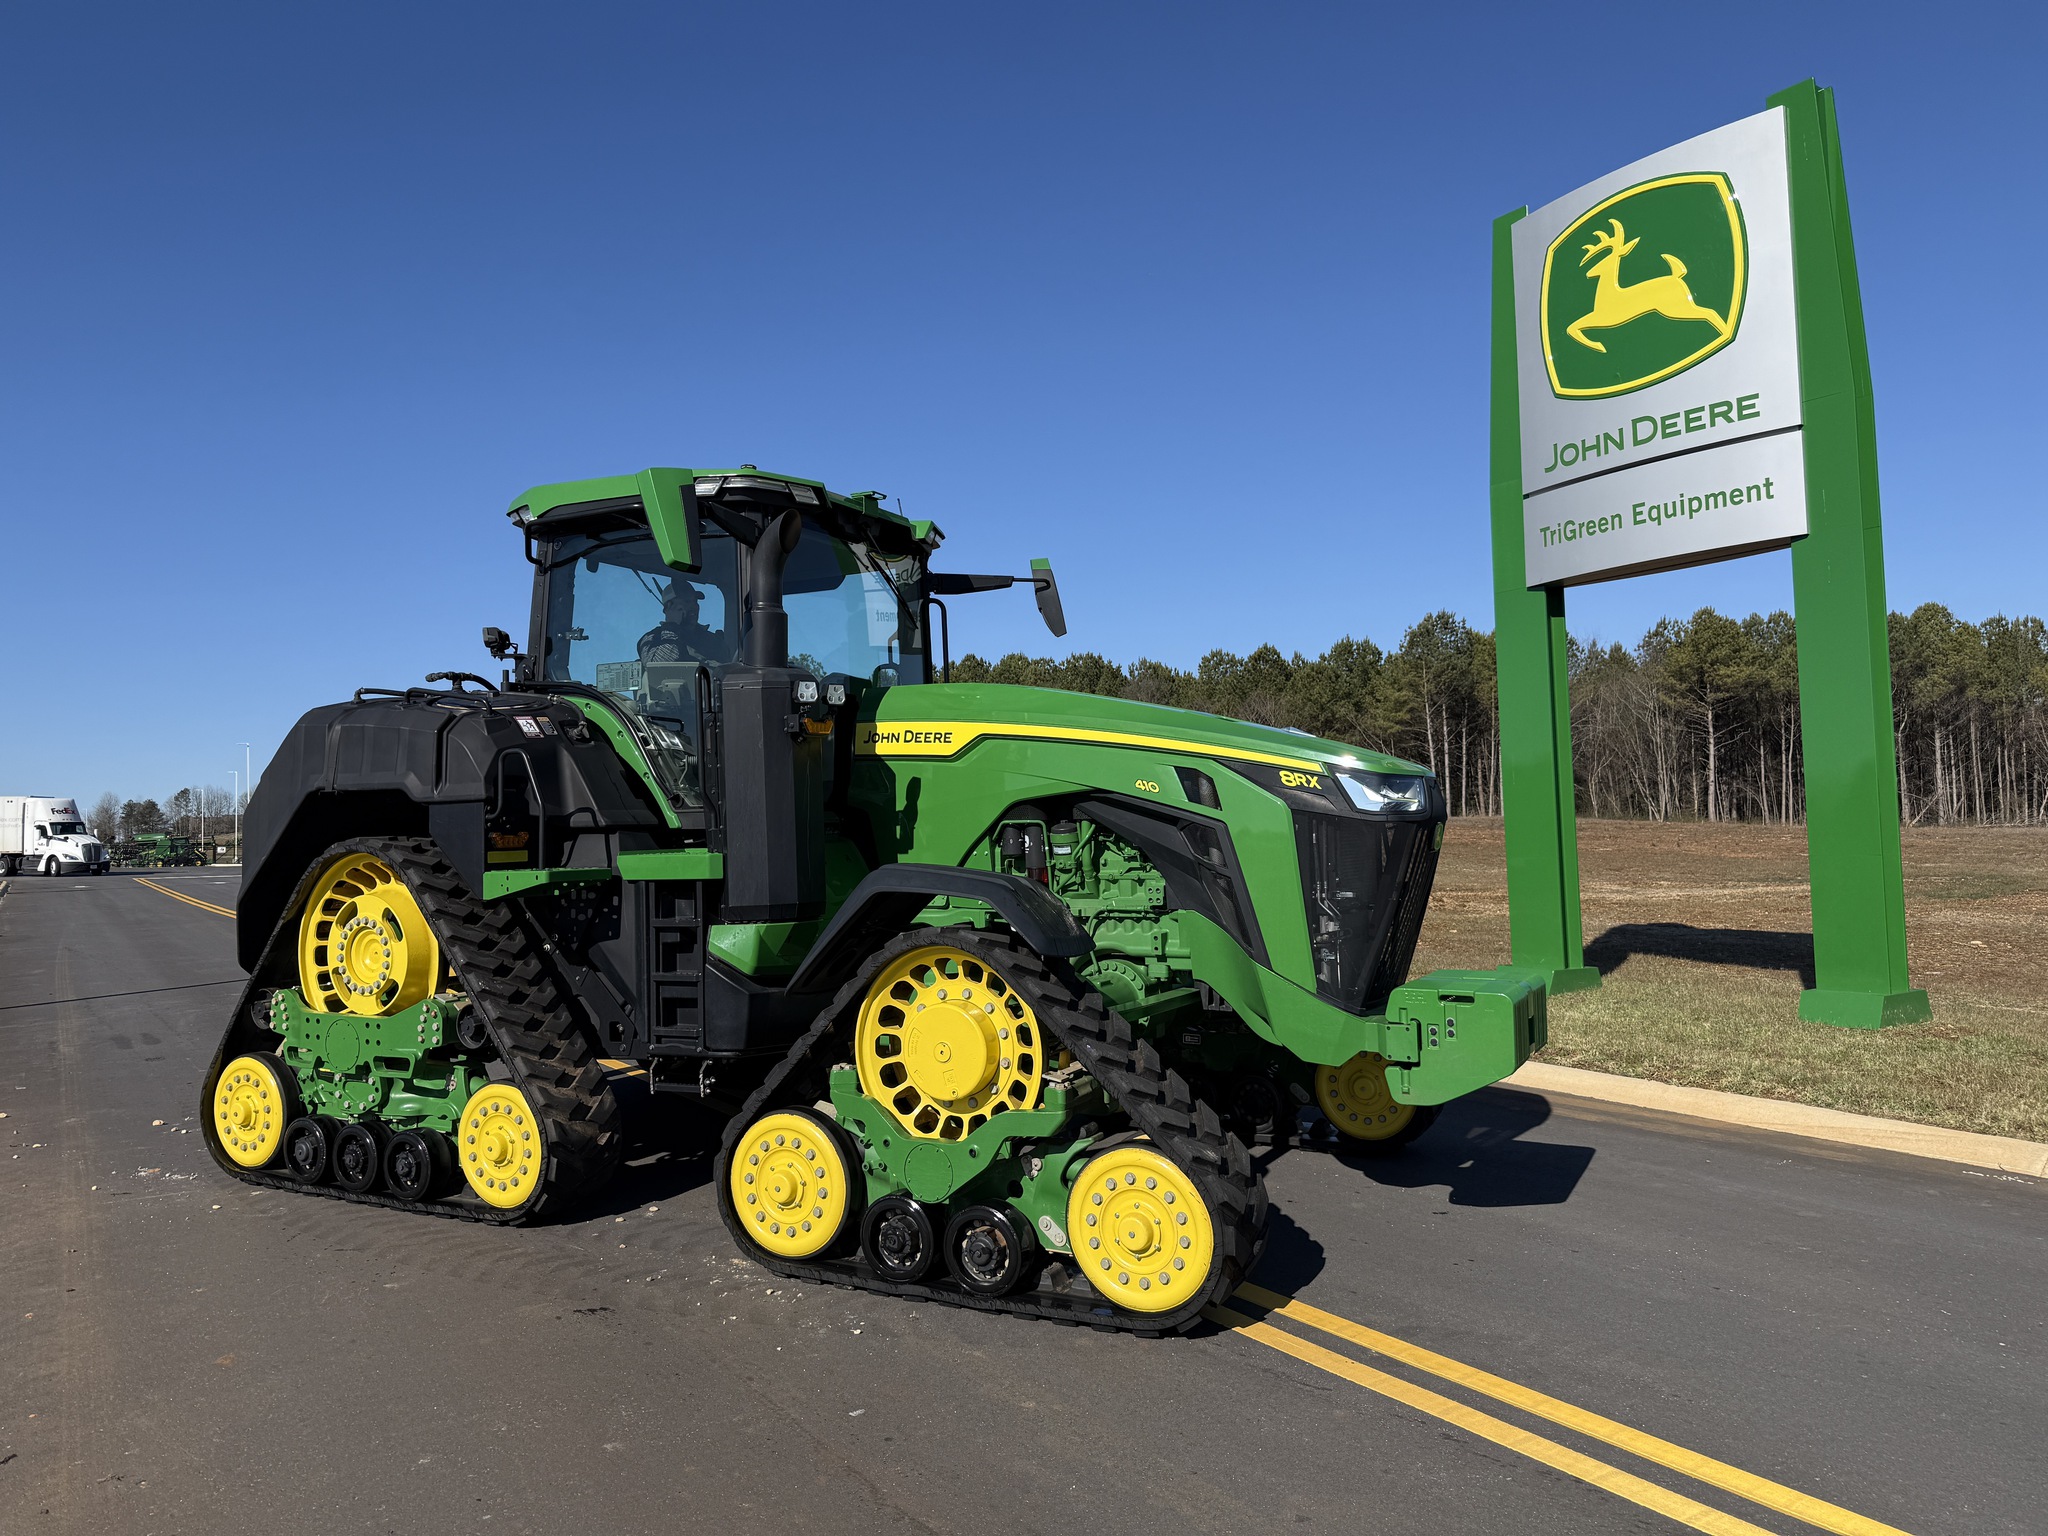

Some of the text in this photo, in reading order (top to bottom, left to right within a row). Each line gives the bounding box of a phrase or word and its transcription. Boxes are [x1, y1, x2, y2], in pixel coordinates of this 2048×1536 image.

[1544, 393, 1760, 473] JOHN DEERE
[1540, 477, 1774, 547] TriGreen Equipment
[863, 730, 953, 744] JOHN DEERE
[1135, 779, 1160, 793] 410
[1279, 770, 1322, 790] 8RX
[51, 807, 76, 815] FedEx
